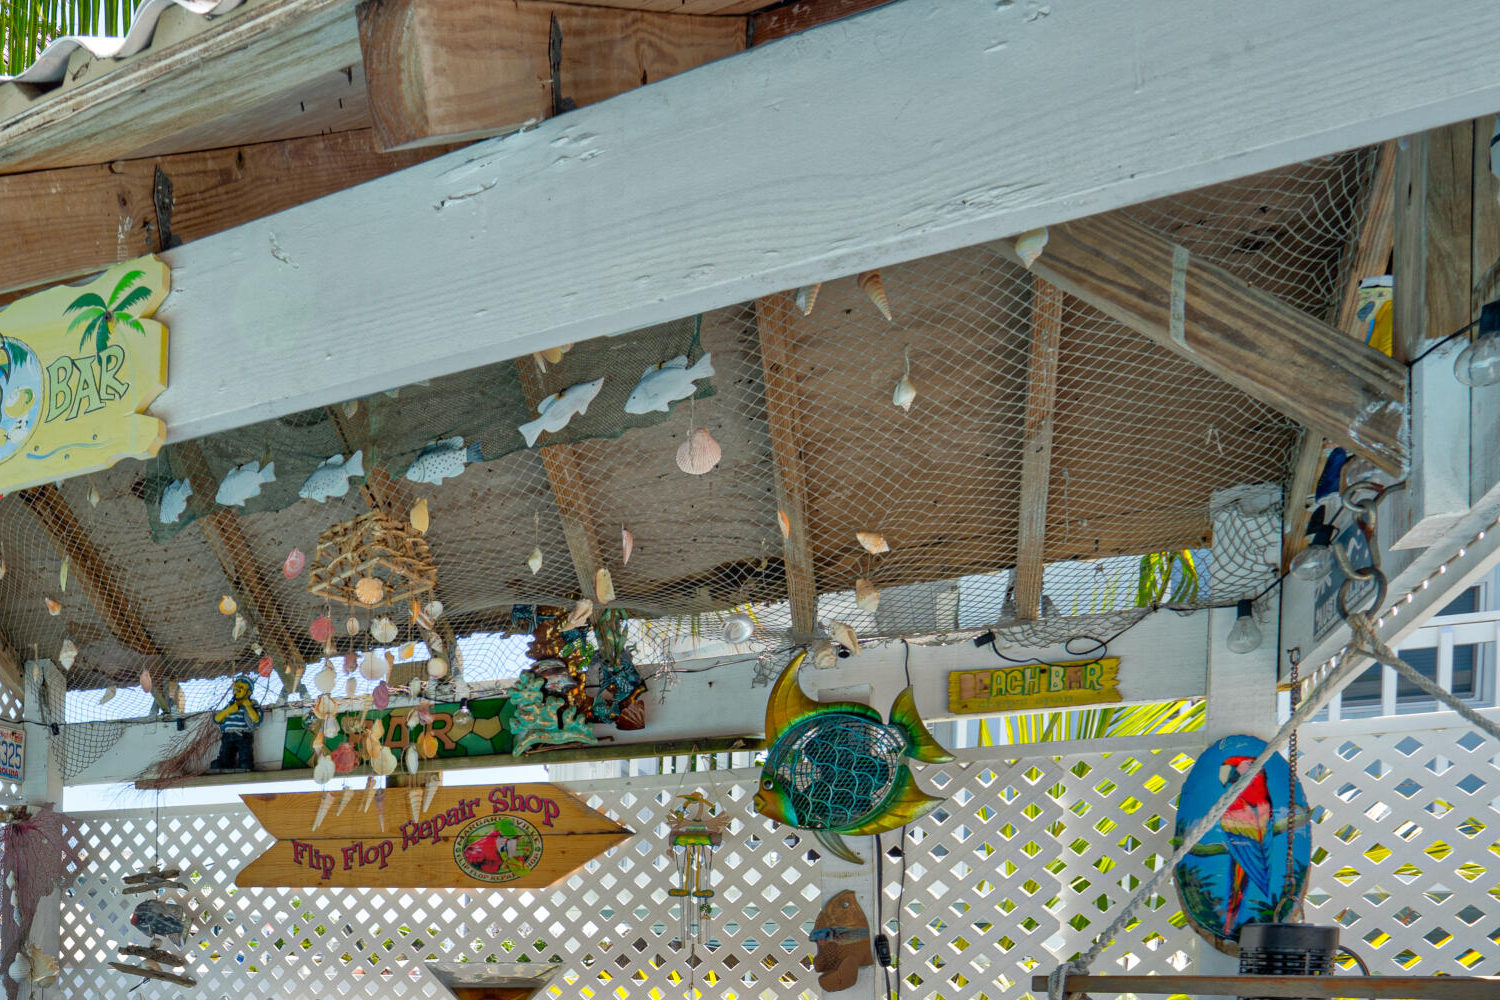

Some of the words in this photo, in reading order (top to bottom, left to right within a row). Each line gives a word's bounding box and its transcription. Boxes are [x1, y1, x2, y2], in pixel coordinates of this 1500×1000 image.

[44, 345, 130, 423] BAR
[959, 667, 1041, 699] BEACH
[1048, 662, 1104, 692] BAR
[291, 838, 335, 880] Flip
[341, 839, 394, 870] Flop
[400, 796, 481, 850] Repair
[487, 784, 560, 827] Shop
